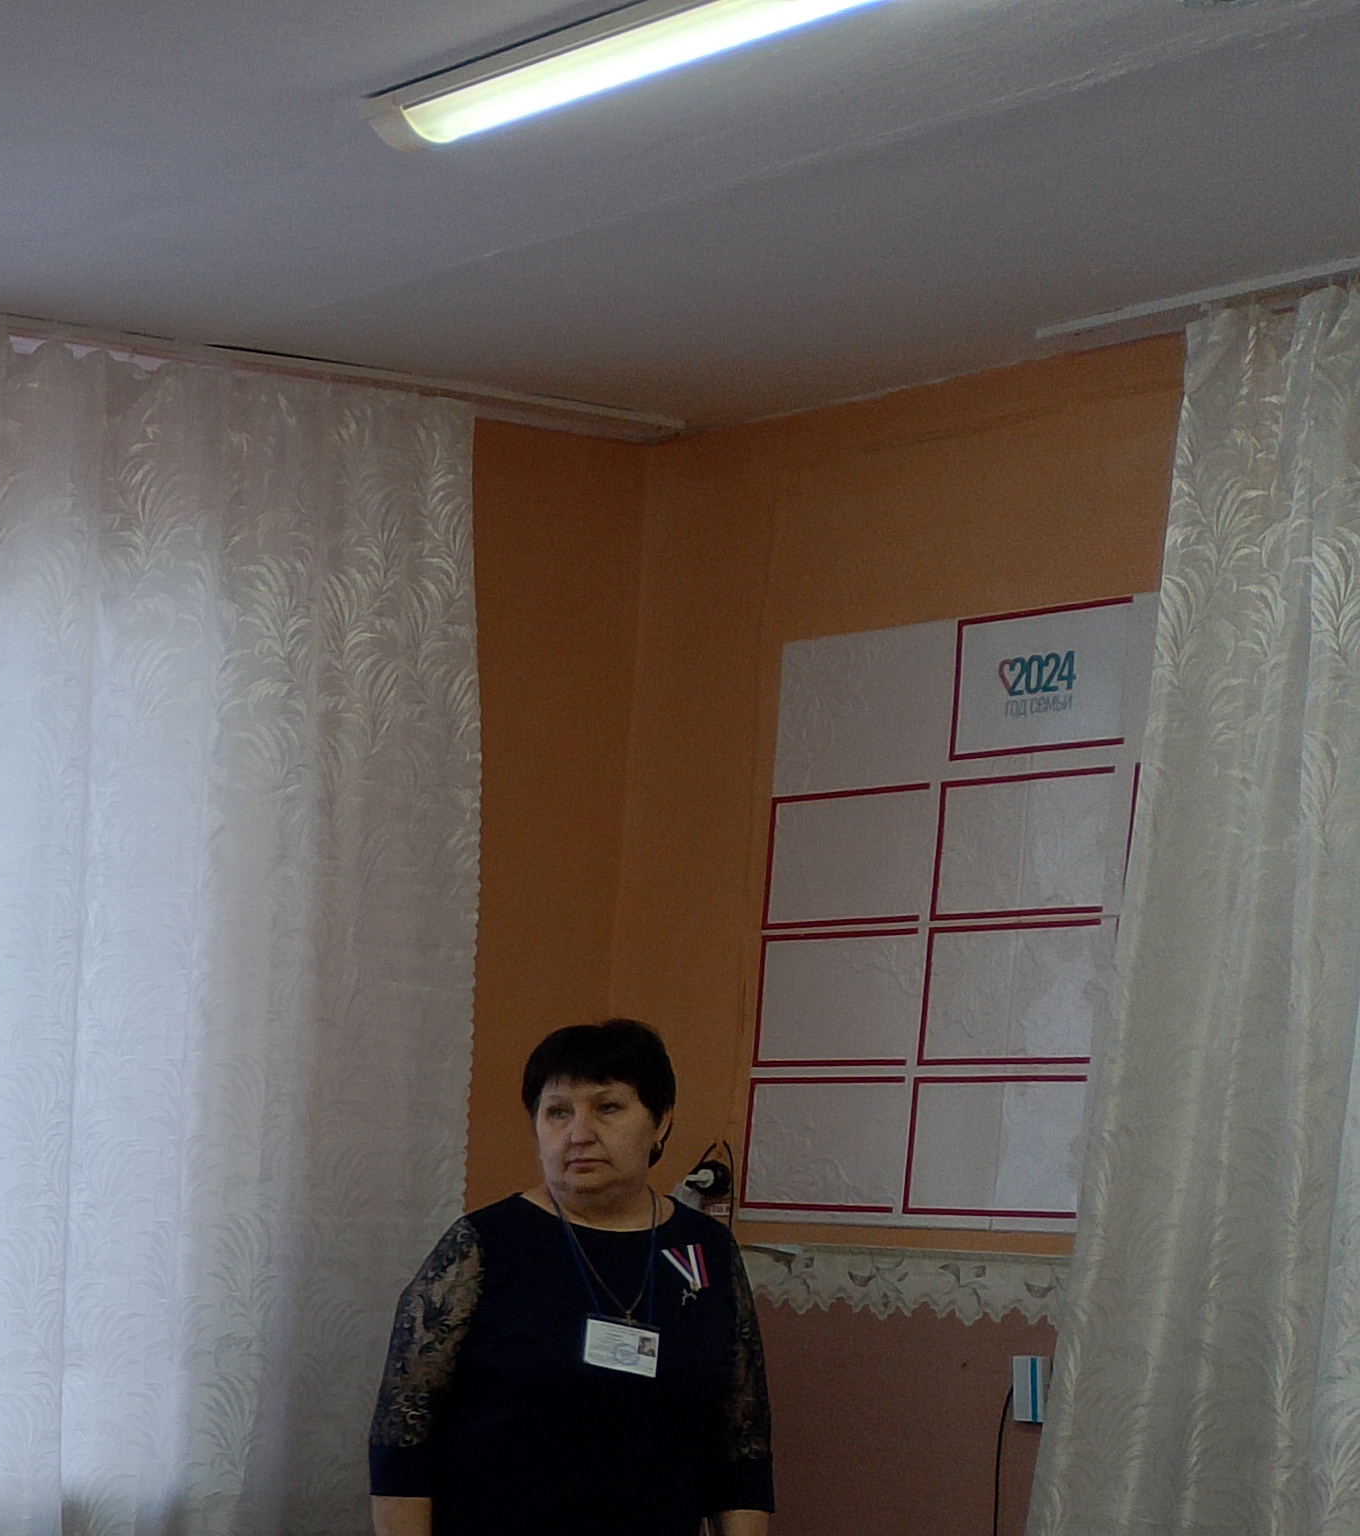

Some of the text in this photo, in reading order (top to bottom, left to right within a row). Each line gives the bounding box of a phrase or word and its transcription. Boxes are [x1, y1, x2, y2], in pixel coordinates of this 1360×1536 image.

[1008, 650, 1076, 697] 2024
[1004, 695, 1073, 718] ГОД СЕМЬИ
